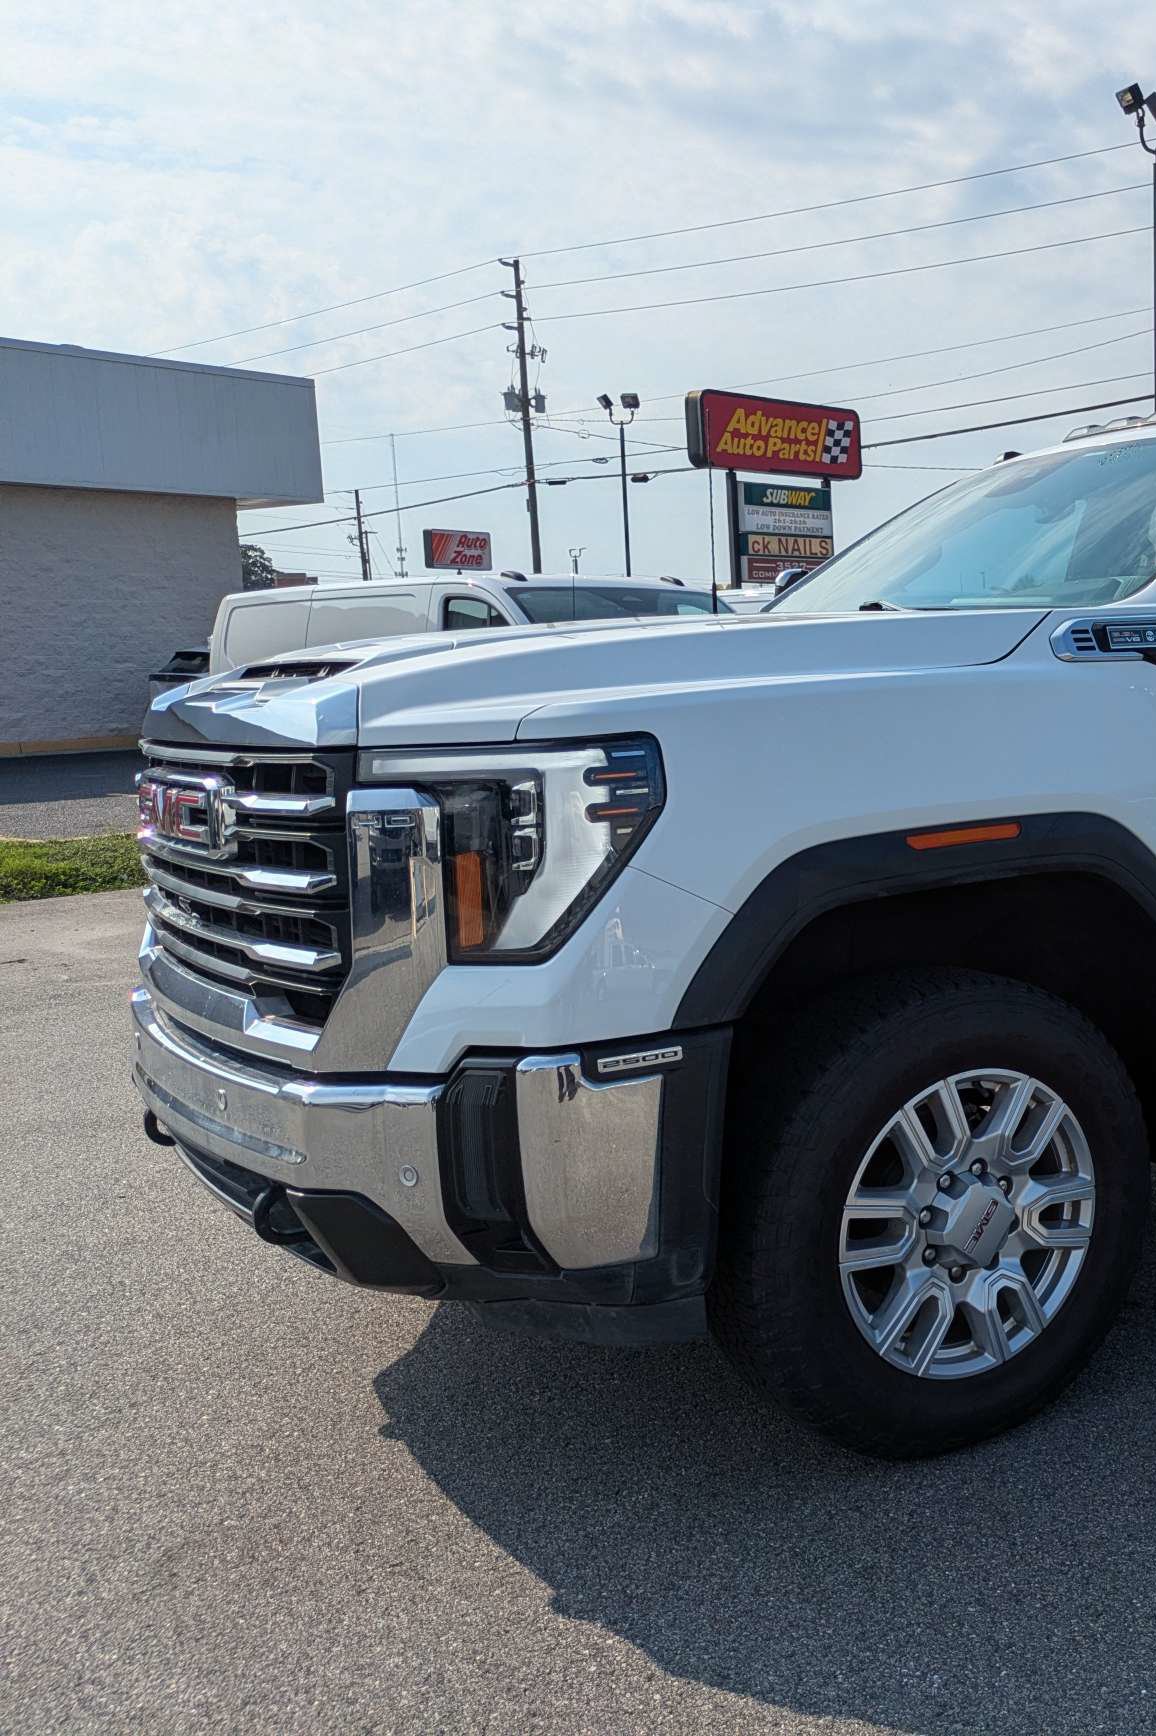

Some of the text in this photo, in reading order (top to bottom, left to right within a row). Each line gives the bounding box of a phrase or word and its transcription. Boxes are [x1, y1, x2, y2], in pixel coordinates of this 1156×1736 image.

[727, 408, 820, 441] Advance
[716, 432, 817, 462] Auto Parts
[763, 488, 817, 506] SUBWAY
[761, 509, 777, 517] AUTO
[756, 523, 824, 534] LOW DOWN PAYMENT
[457, 533, 487, 549] Auto
[777, 538, 830, 556] NAILS
[449, 550, 484, 566] Zone
[597, 1045, 683, 1073] 2500
[963, 1199, 999, 1255] GMC
